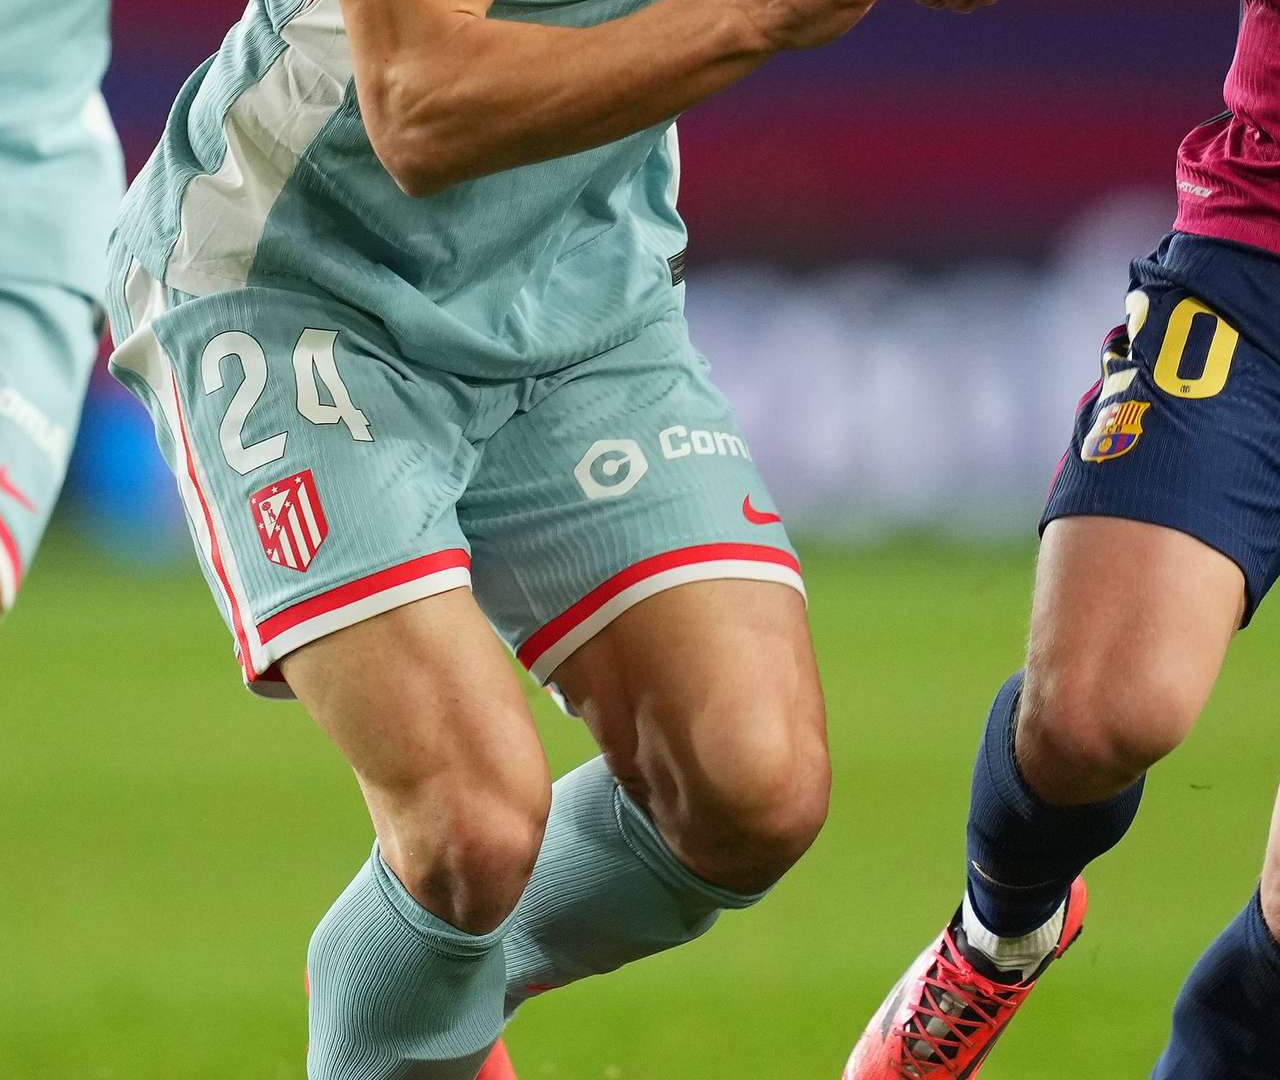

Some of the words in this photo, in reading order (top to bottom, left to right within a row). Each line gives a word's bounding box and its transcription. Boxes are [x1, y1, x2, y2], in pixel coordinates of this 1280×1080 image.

[200, 327, 376, 476] 24
[1097, 289, 1240, 405] 20
[658, 424, 753, 462] Com
